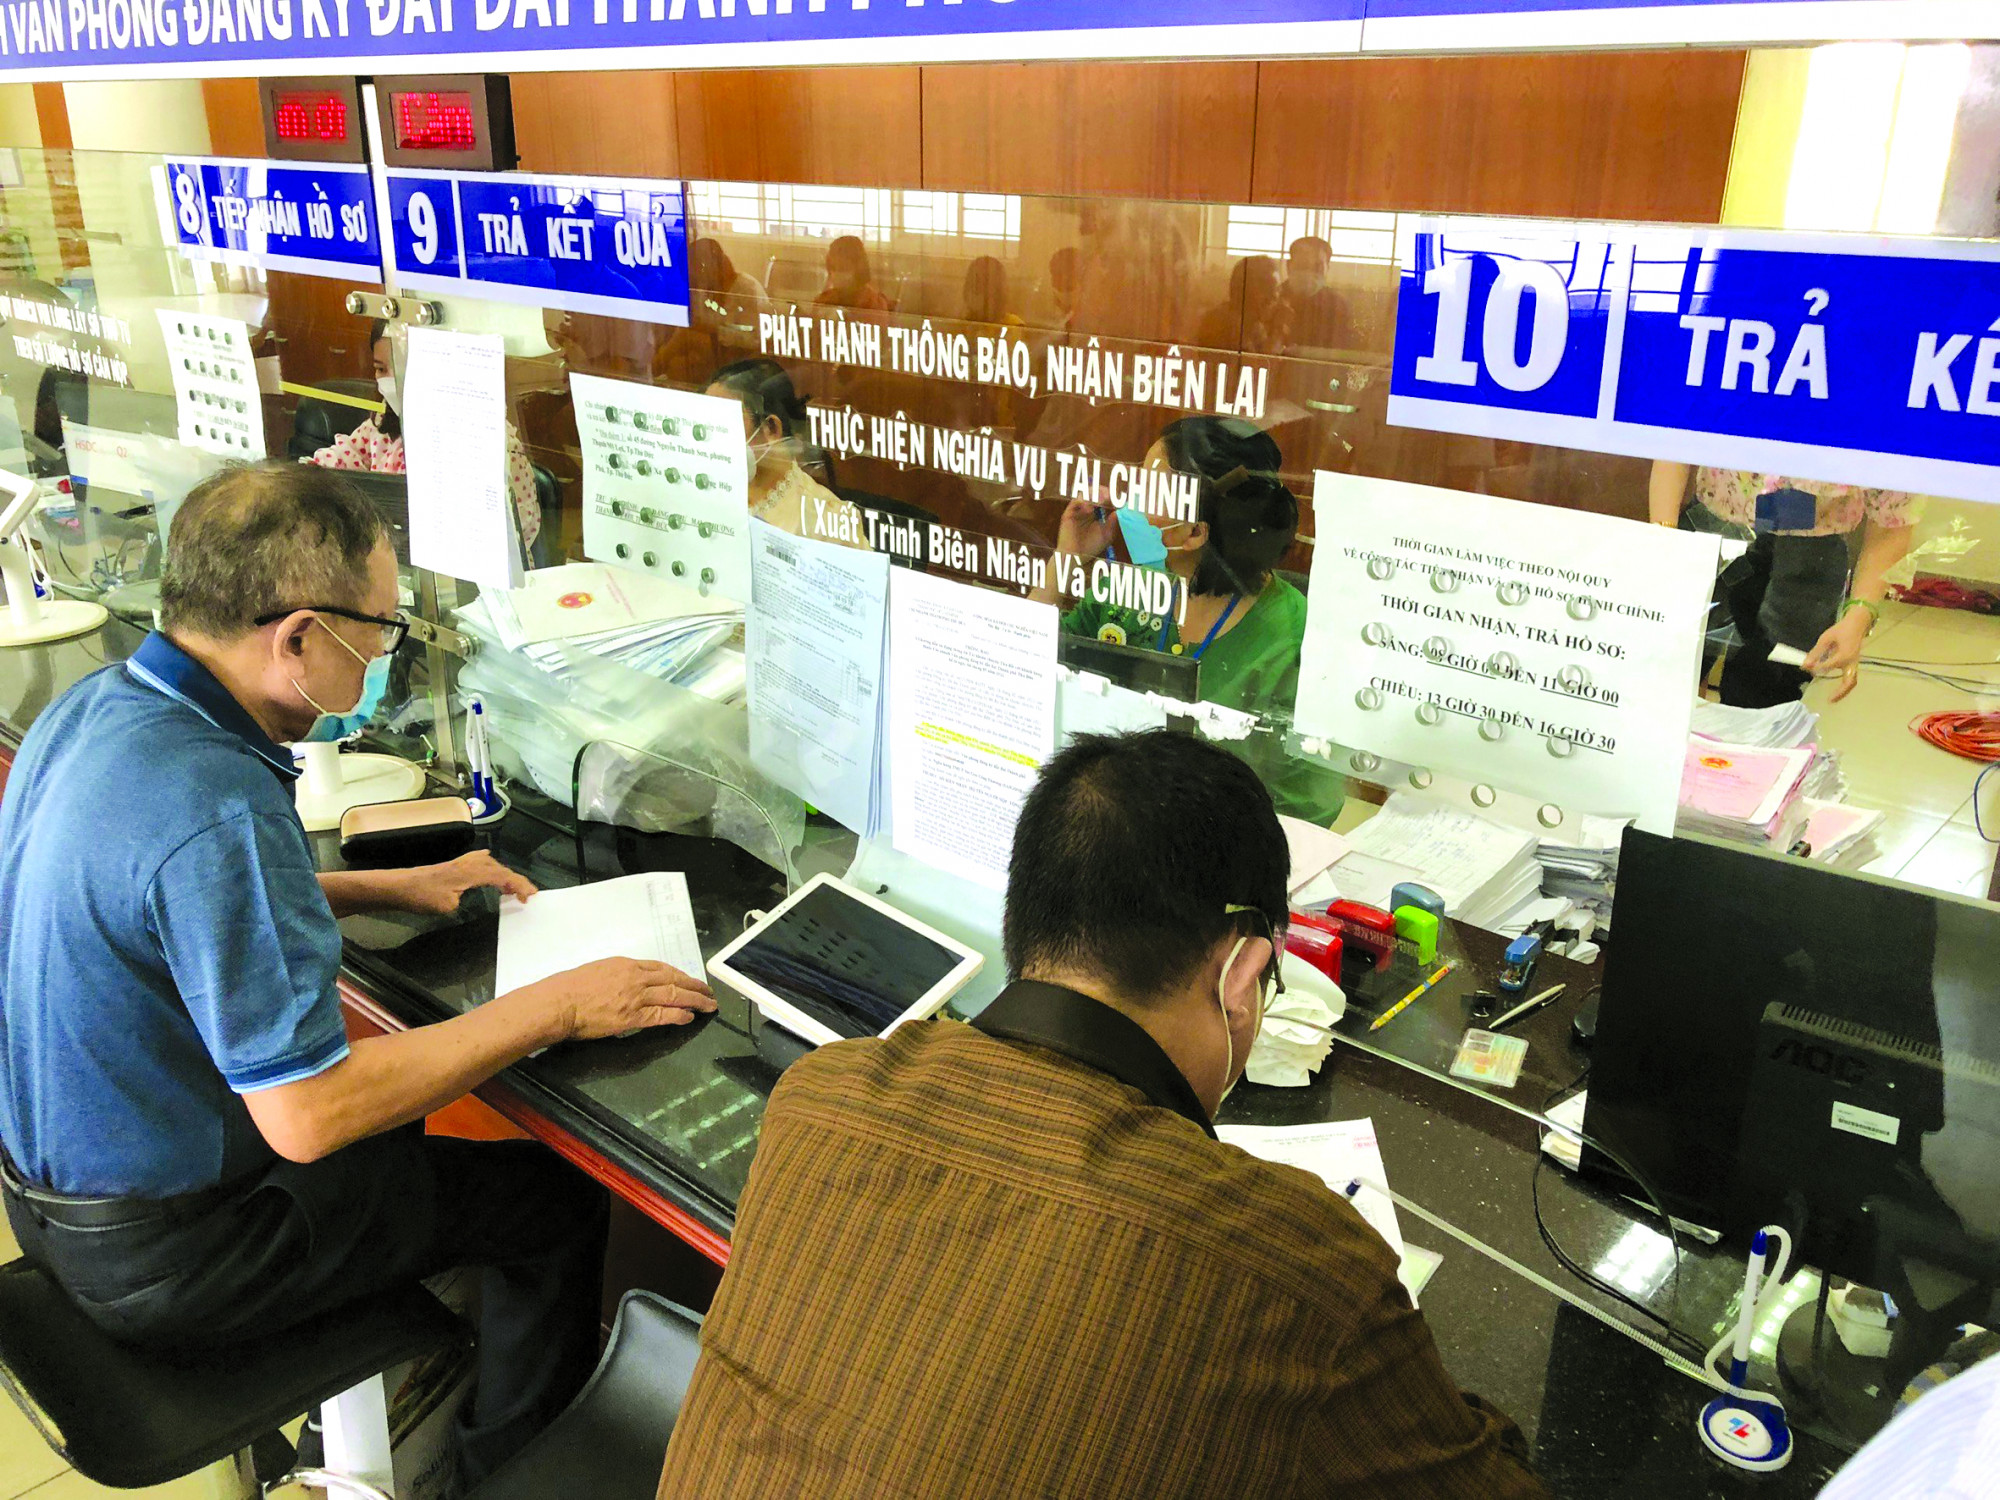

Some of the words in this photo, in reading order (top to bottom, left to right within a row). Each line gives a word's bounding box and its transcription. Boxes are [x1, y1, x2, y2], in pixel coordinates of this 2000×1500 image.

[176, 173, 201, 235] 8
[212, 179, 250, 232] TIẾP
[306, 182, 335, 240] HỒ
[340, 200, 369, 243] SƠ
[408, 191, 439, 265] 9
[478, 196, 529, 256] TRẢ
[546, 193, 595, 262] KẾT
[614, 201, 673, 269] QUẢ
[759, 304, 813, 360] PHÁT
[820, 309, 881, 368] HÀNH
[887, 319, 969, 382] THÔNG
[977, 326, 1038, 399] BÁO,
[1047, 336, 1124, 407] NHẬN
[1133, 344, 1207, 411] BIÊN
[1215, 362, 1268, 419] LAI
[1414, 256, 1571, 393] 10
[1679, 287, 1830, 399] TRẢ
[806, 404, 865, 461] THỰC
[871, 410, 926, 472] HIỆN
[933, 426, 1006, 484] NGHĨA
[1012, 443, 1047, 501] VỤ
[1056, 443, 1101, 504] TÀI
[1109, 458, 1199, 524] CHÍNH
[813, 497, 860, 545] Xuất
[864, 509, 922, 560] Trình
[928, 523, 979, 574] Biên
[986, 537, 1046, 595] Nhận
[1054, 551, 1086, 599] Và
[1091, 559, 1173, 616] CMND
[1393, 536, 1421, 551] THỜI
[1424, 542, 1455, 557] GIAN
[1456, 549, 1483, 563] LÀM
[1486, 554, 1516, 571] VIỆC
[1517, 560, 1554, 577] THEO
[1557, 568, 1580, 584] NỘI
[1583, 573, 1613, 589] QUY
[1395, 557, 1419, 572] TÁC
[1616, 601, 1666, 623] CHÍNH:
[1381, 592, 1419, 615] THỜI
[1423, 603, 1465, 624] GIAN
[1469, 612, 1521, 640] NHẬN,
[1525, 625, 1560, 647] TRẢ
[1564, 633, 1594, 653] HỒ
[1596, 642, 1626, 660] SƠ:
[1379, 635, 1424, 659] SÁNG:
[1446, 652, 1479, 672] GIỜ
[1542, 675, 1558, 690] 11
[1601, 688, 1620, 704] 00
[1369, 676, 1422, 702] CHIỀU:
[1428, 691, 1442, 706] 13
[1445, 696, 1478, 715] GIỜ
[1479, 705, 1496, 720] 30
[1500, 710, 1536, 731] ĐẾN
[1539, 721, 1556, 736] 16
[1560, 725, 1596, 746] GIỜ
[1597, 735, 1617, 751] 30
